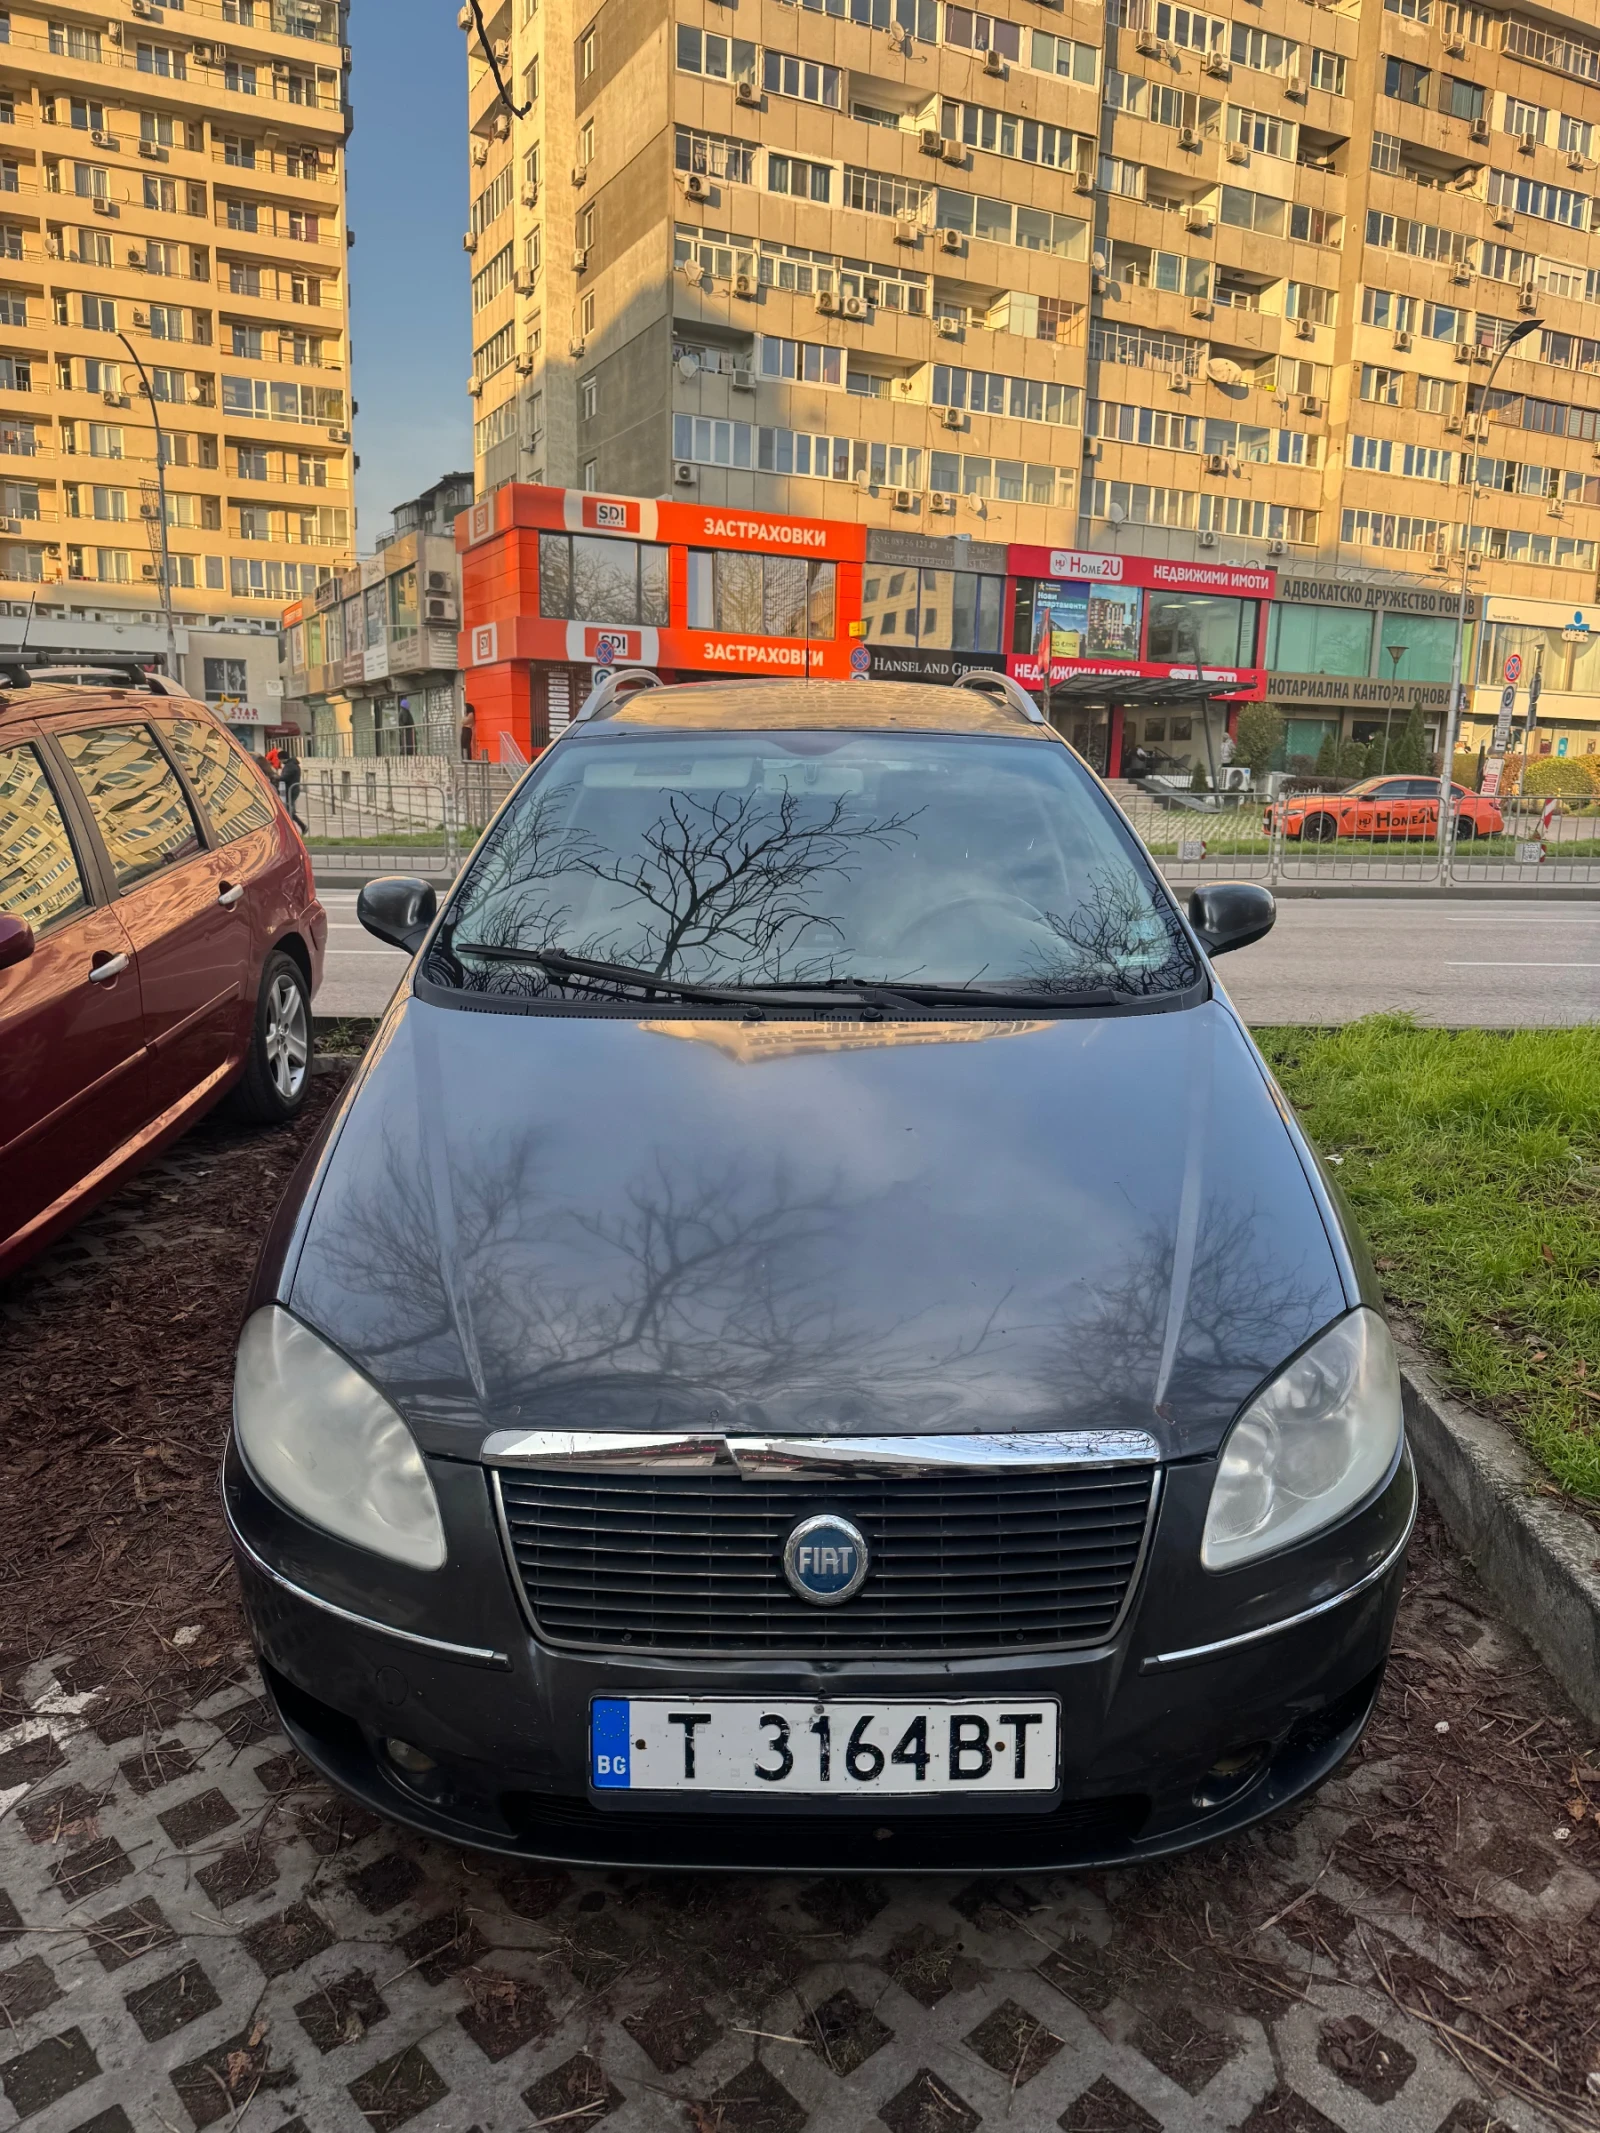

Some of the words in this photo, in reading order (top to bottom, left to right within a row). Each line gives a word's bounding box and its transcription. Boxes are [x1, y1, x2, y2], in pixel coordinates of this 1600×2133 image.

[599, 505, 624, 521] SDI
[704, 518, 827, 547] ЗАСТРАХОВКИ
[1153, 564, 1229, 586] НЕДВИЖИМИ
[1231, 573, 1269, 590] ИМОТИ
[1037, 591, 1058, 601] Нови
[1037, 600, 1087, 611] апартаменти
[1283, 579, 1363, 604] АДВОКАТСКО
[1365, 588, 1436, 611] ДРУЖЕСТВО
[703, 642, 824, 667] ЗАСТРАХОВКИ
[1014, 663, 1096, 681] НЕДИЖИМИ
[1267, 678, 1349, 700] НОТАРИАЛНА
[1352, 683, 1405, 702] КАНТОРА
[1408, 686, 1451, 705] ГОНОВА
[230, 707, 259, 717] STAR
[799, 1546, 853, 1575] FIAT
[668, 1712, 711, 1779] T
[597, 1754, 627, 1776] BG
